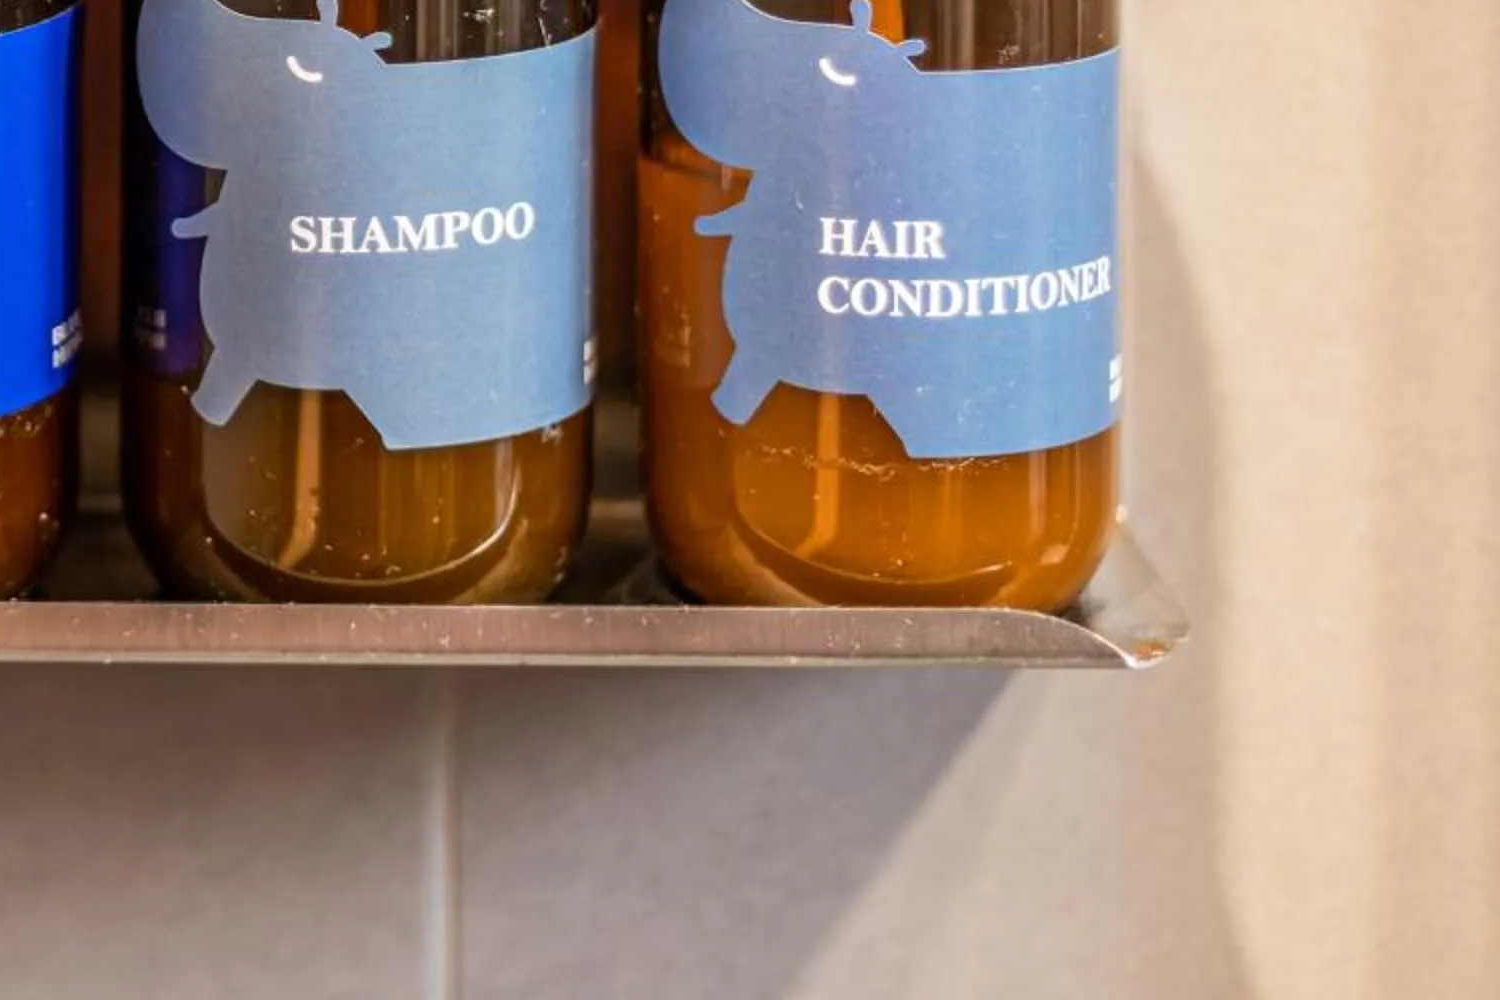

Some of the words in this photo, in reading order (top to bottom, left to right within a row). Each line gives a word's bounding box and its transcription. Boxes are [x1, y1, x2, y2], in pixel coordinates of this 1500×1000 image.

[289, 201, 536, 254] SHAMPOO
[818, 217, 947, 260] HAIR
[816, 255, 1112, 318] CONDITIONER
